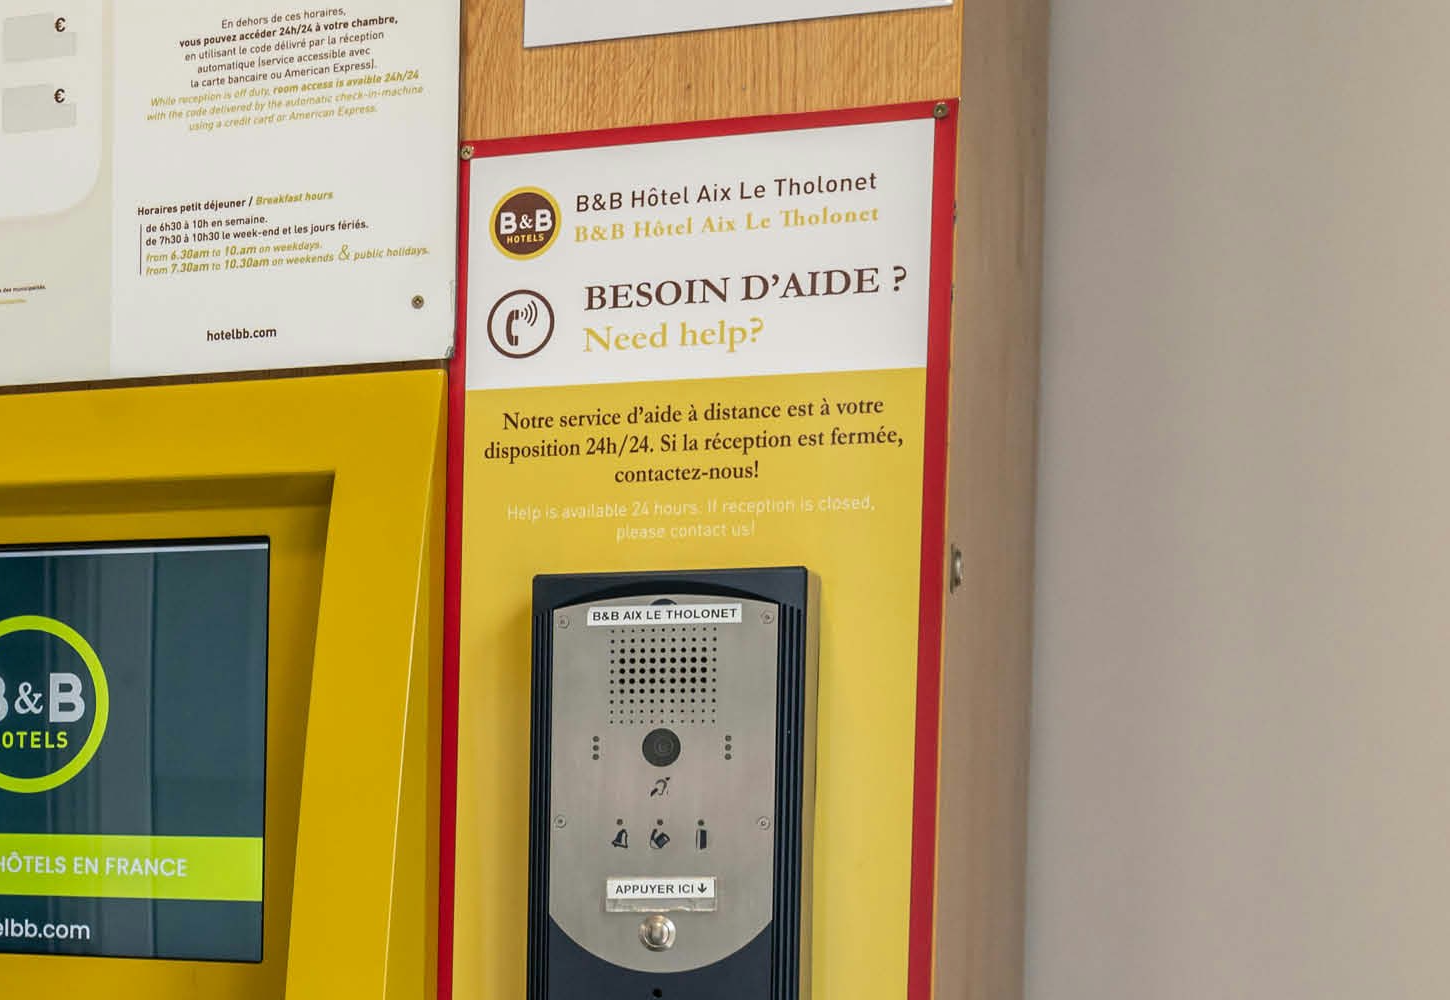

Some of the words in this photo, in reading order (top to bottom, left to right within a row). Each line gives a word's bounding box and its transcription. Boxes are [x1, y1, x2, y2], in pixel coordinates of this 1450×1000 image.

[54, 17, 66, 33] €
[221, 19, 233, 29] En
[236, 17, 268, 27] dehors
[270, 13, 282, 23] de
[284, 13, 301, 21] ces
[303, 8, 346, 18] horaires,
[179, 38, 201, 47] vous
[203, 34, 236, 46] pouvez
[239, 29, 276, 40] accéder
[279, 23, 312, 35] 24h/24
[315, 22, 320, 32] à
[323, 21, 348, 30] votre
[351, 16, 397, 27] chambre,
[184, 53, 196, 61] en
[198, 47, 236, 59] utilisant
[238, 45, 247, 55] le
[249, 43, 271, 53] code
[274, 38, 306, 50] délivré
[308, 38, 325, 49] par
[327, 35, 336, 45] la
[339, 31, 384, 43] réception
[190, 79, 199, 88] la
[201, 77, 225, 86] carte
[227, 73, 267, 84] bancaire
[284, 66, 330, 77] American
[53, 88, 65, 104] €
[576, 192, 622, 212] B&B
[631, 186, 688, 207] Hôtel
[696, 183, 730, 202] Aix
[740, 182, 765, 199] Le
[775, 173, 876, 196] Tholonet
[137, 205, 177, 215] Horaires
[180, 202, 201, 214] petit
[203, 199, 246, 211] déjeuner
[256, 194, 302, 204] Breakfast
[145, 223, 157, 232] de
[159, 221, 181, 231] 6h30
[183, 220, 189, 229] à
[192, 219, 208, 228] 10h
[211, 219, 222, 227] en
[225, 216, 267, 226] semaine.
[145, 237, 156, 246] de
[159, 234, 181, 245] 7h30
[183, 233, 189, 243] à
[192, 231, 219, 241] 10h30
[222, 231, 230, 239] le
[232, 226, 279, 238] week-end
[282, 226, 291, 235] et
[294, 224, 308, 233] les
[310, 223, 335, 234] jours
[337, 219, 369, 230] fériés.
[499, 208, 553, 235] B&B
[574, 223, 624, 242] B&B
[634, 216, 692, 237] Hôtel
[701, 216, 735, 232] Aix
[746, 212, 770, 229] Le
[781, 207, 879, 226] Tholonet
[505, 233, 545, 245] HOTELS
[584, 278, 730, 310] BESOIN
[206, 328, 276, 340] hotelbb.com
[583, 322, 667, 351] Need
[679, 317, 764, 352] help?
[503, 412, 553, 429] Notre
[559, 408, 620, 427] service
[688, 404, 697, 421] à
[703, 402, 780, 420] distance
[787, 403, 813, 417] est
[820, 398, 830, 415] à
[836, 400, 883, 414] votre
[484, 439, 580, 464] disposition
[586, 435, 653, 456] 24h/24.
[660, 433, 676, 452] Si
[682, 433, 698, 451] la
[704, 430, 790, 454] réception
[797, 432, 823, 446] est
[831, 426, 902, 446] fermée,
[614, 460, 758, 482] contactez-nous!
[592, 611, 619, 621] B&B
[623, 610, 641, 620] AIX
[646, 610, 661, 619] LE
[666, 608, 737, 618] THOLONET
[73, 856, 98, 874] EN
[105, 857, 186, 876] FRANCE
[615, 884, 674, 894] APPUYER
[678, 883, 693, 893] ICI
